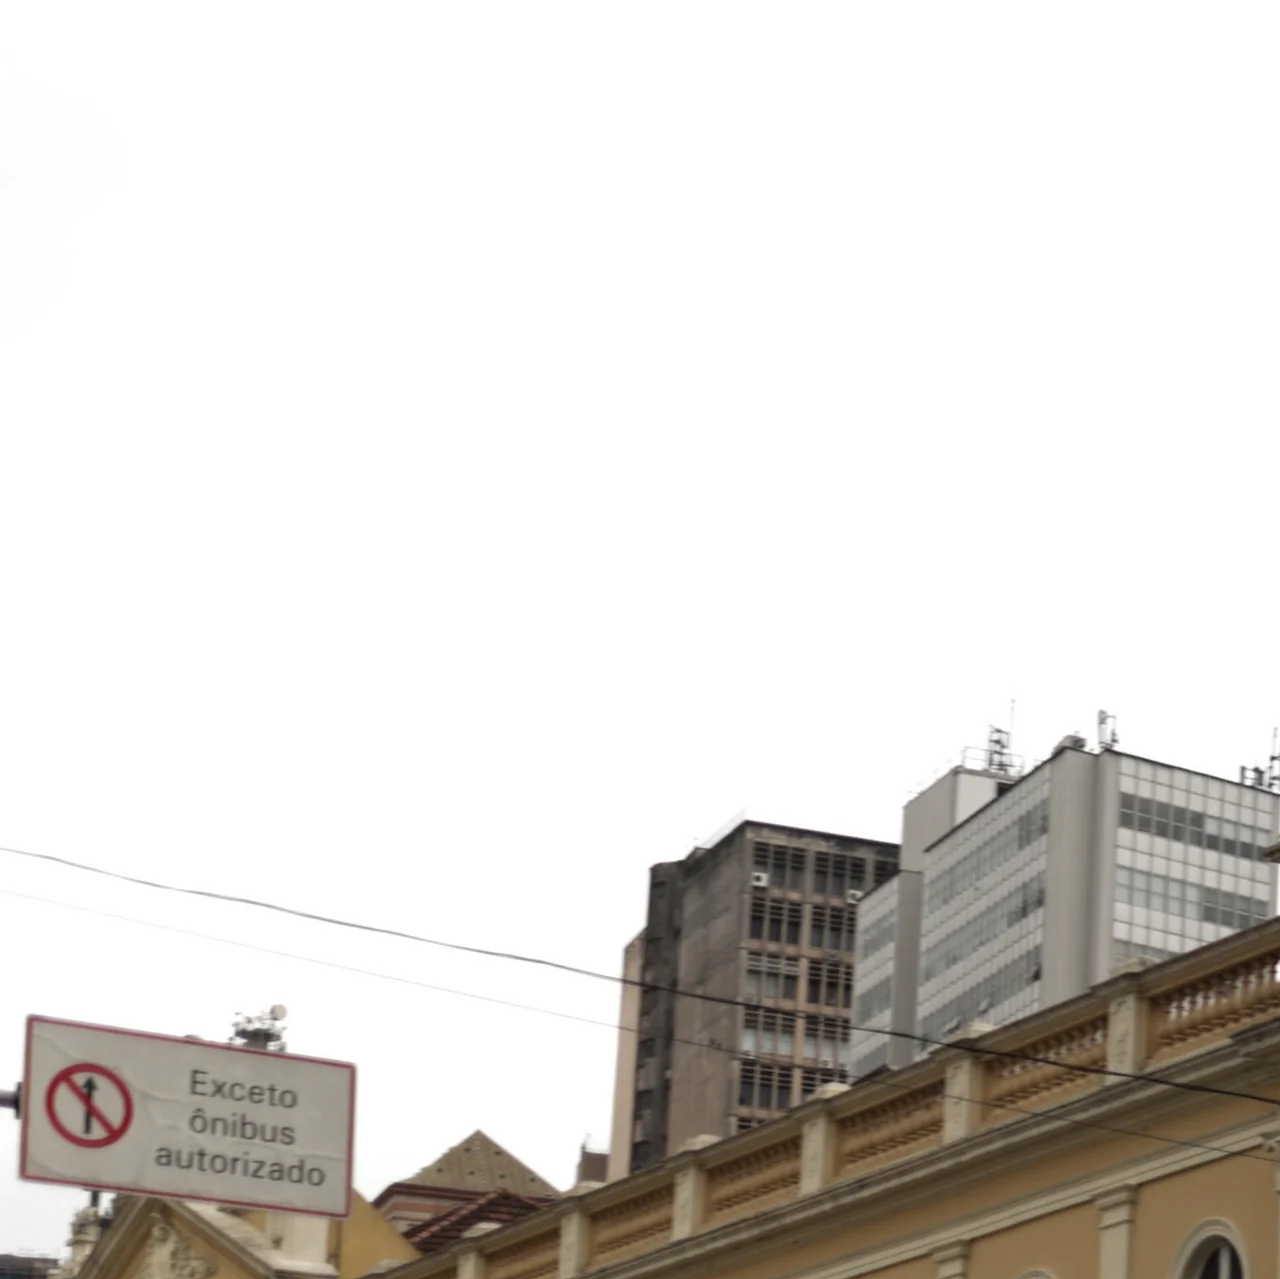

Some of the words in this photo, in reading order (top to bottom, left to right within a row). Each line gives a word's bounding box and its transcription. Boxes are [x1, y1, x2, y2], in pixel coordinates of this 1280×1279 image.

[189, 1068, 299, 1110] Exceto
[188, 1108, 297, 1147] ônibus
[155, 1146, 327, 1188] autorizado
